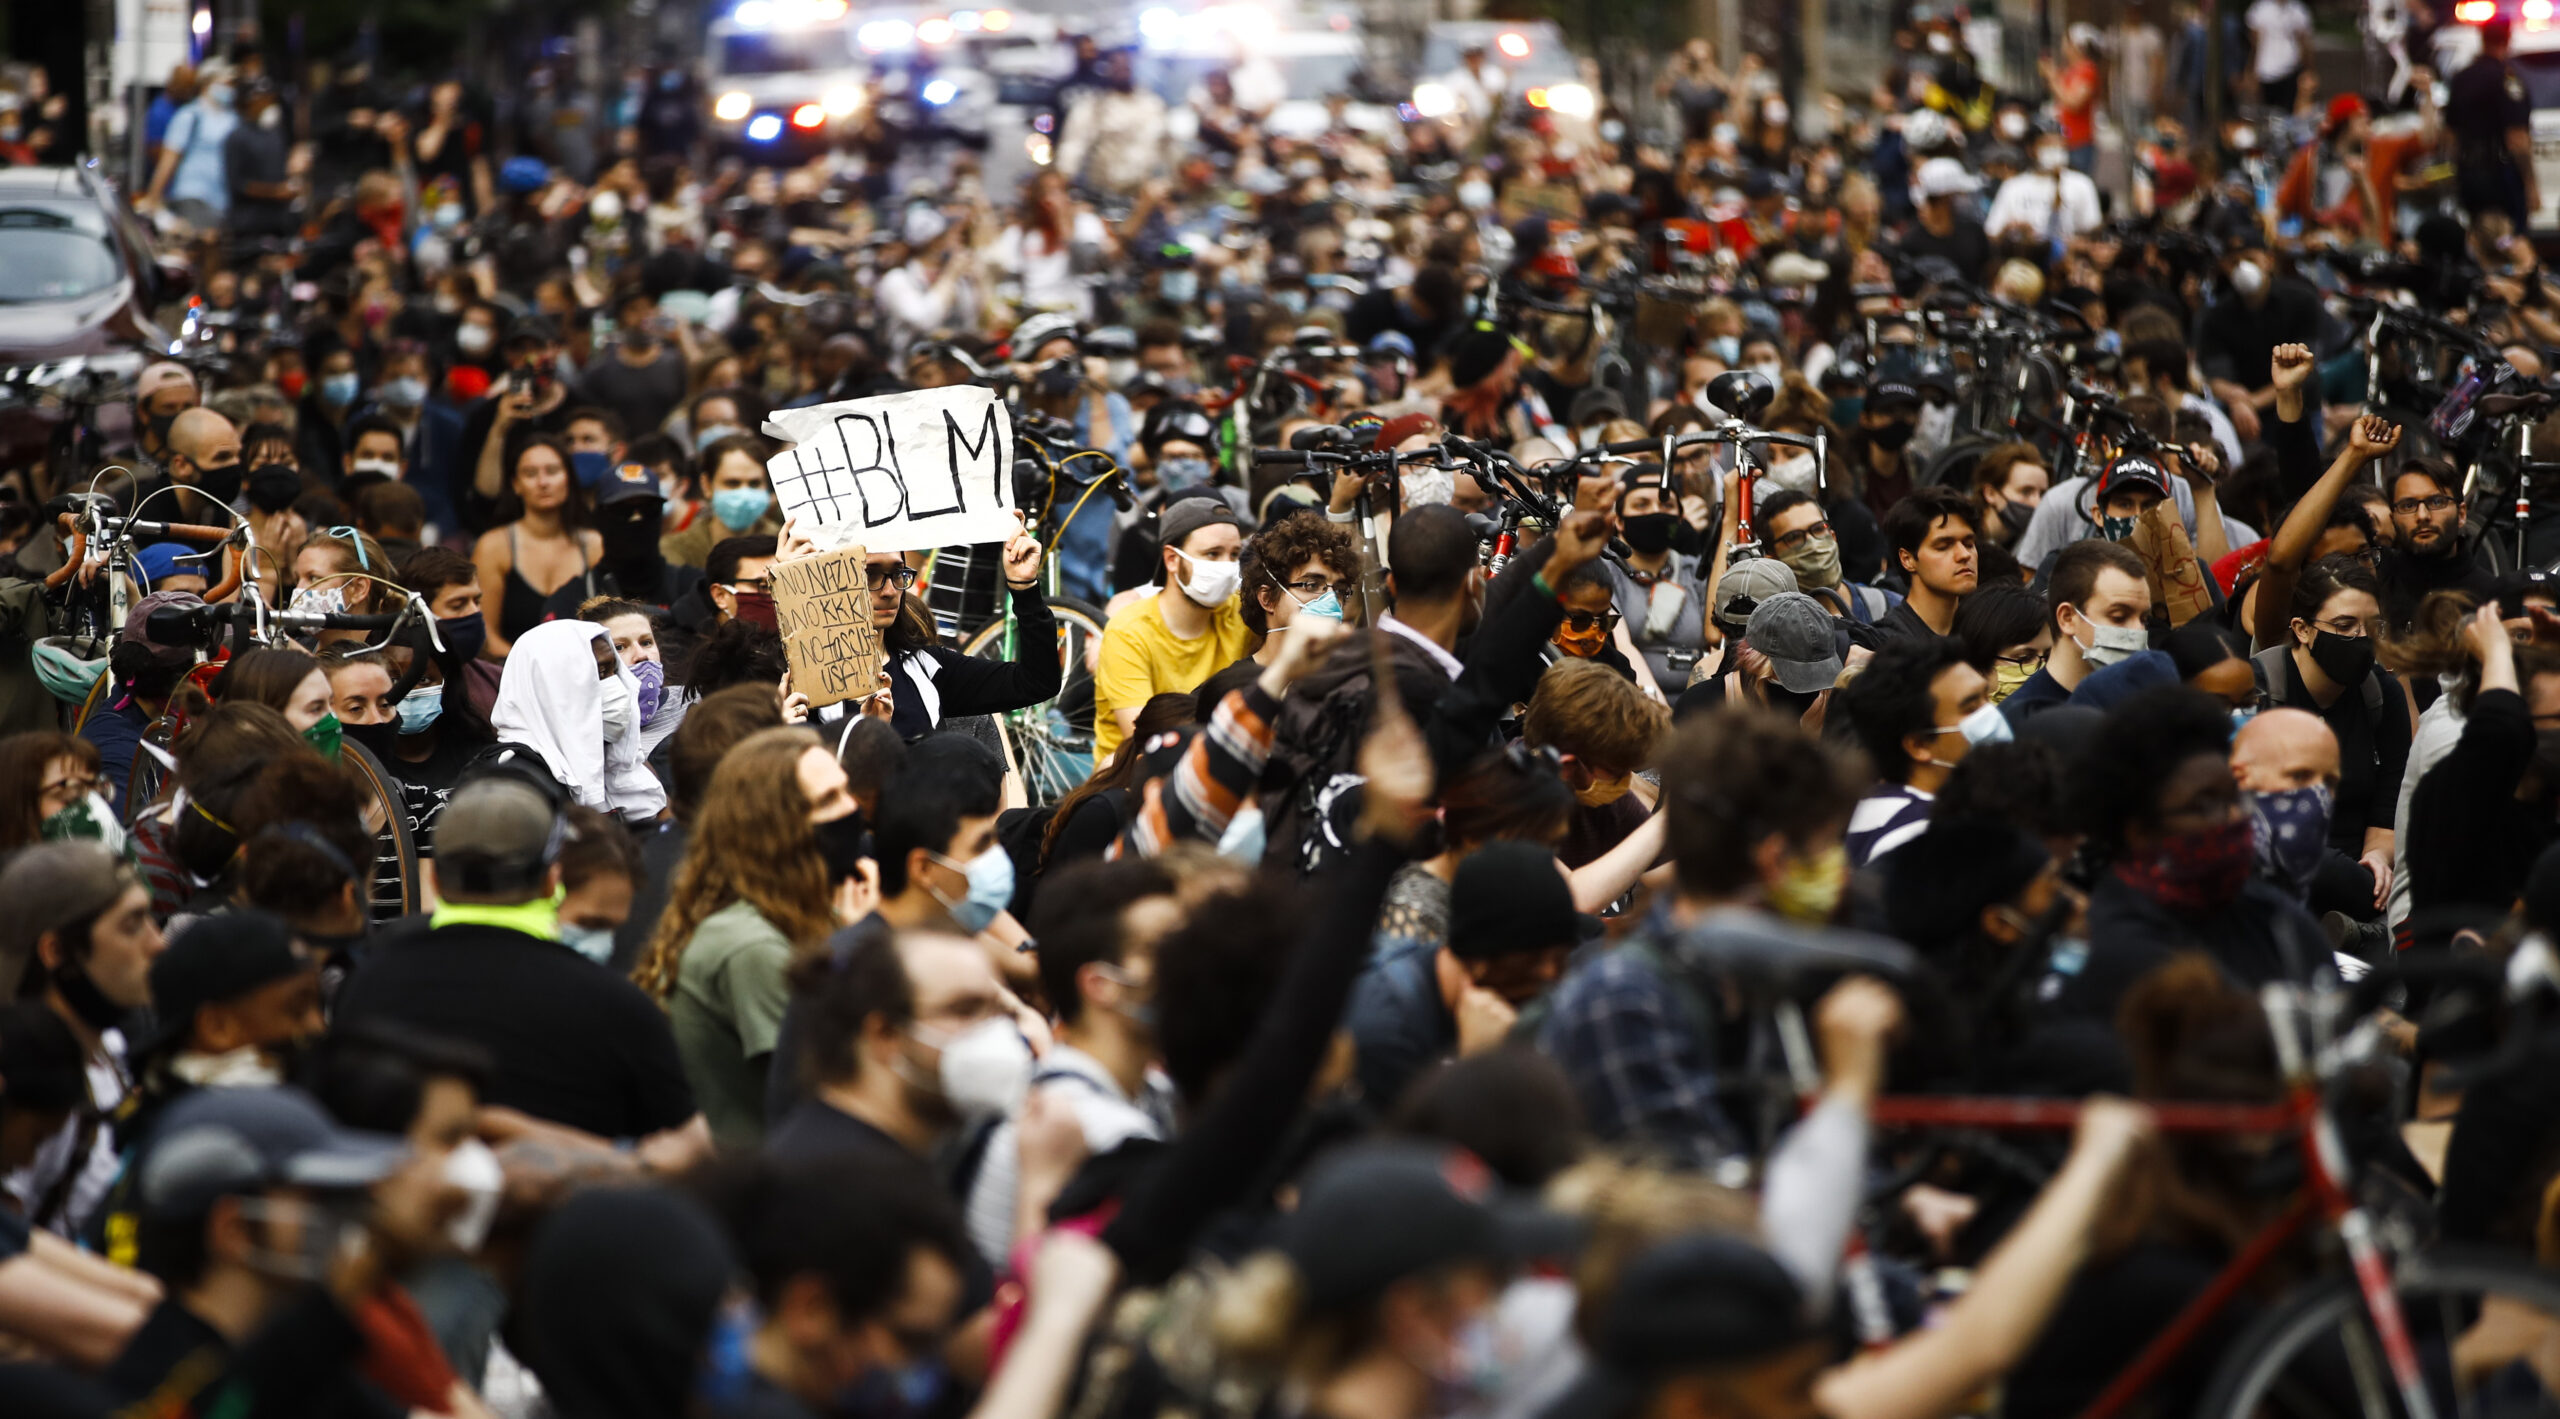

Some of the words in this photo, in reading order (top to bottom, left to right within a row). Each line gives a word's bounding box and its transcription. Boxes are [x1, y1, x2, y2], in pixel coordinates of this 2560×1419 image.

[776, 403, 1003, 528] #BLM
[779, 565, 807, 596] NO
[791, 601, 820, 629] NO
[819, 593, 866, 625] KKK
[799, 636, 825, 668] NO
